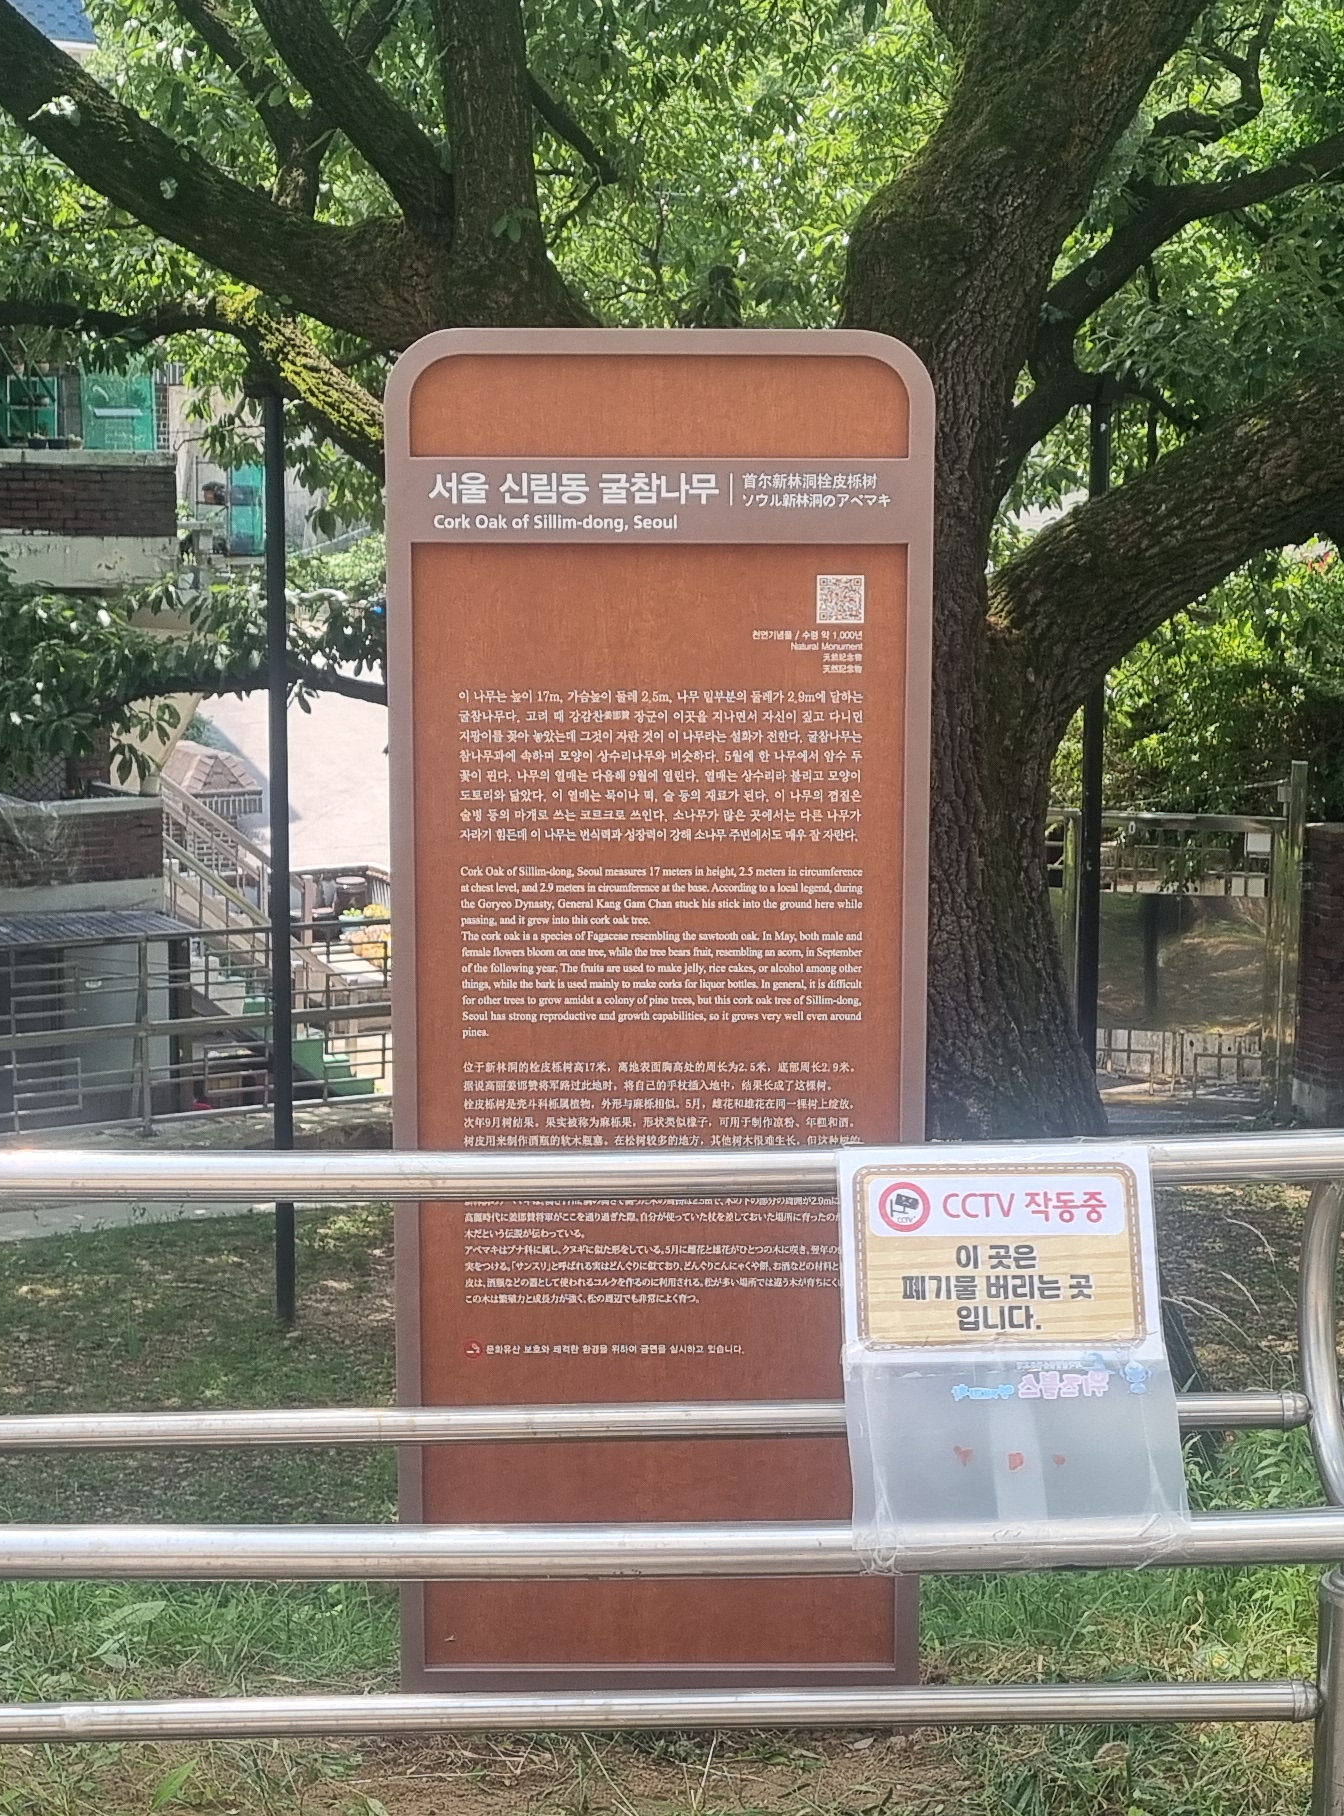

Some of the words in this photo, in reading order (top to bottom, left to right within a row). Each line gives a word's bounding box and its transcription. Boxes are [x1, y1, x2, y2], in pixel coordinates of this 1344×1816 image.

[742, 473, 877, 489] 首尔新林洞栓皮栎树
[429, 473, 489, 504] 서울
[499, 473, 589, 504] 신림동
[599, 473, 719, 504] 굴참나무
[743, 493, 890, 508] ソウル新林洞のアベマキ
[434, 514, 470, 529] Cork
[475, 514, 506, 529] Oak
[512, 513, 529, 529] of
[533, 514, 628, 532] Sillim-dong,
[634, 514, 677, 529] Seoul
[753, 630, 792, 640] 천연기념물
[791, 642, 819, 651] Natural
[822, 642, 862, 651] Monument
[459, 690, 469, 703] 이
[474, 690, 507, 703] 나무는
[511, 690, 532, 703] 높이
[568, 690, 611, 703] 가슴높이
[616, 690, 637, 703] 둘레
[677, 690, 699, 703] 나무
[704, 690, 746, 703] 밑부분의
[751, 690, 784, 703] 둘레가
[830, 690, 863, 703] 달하는
[460, 730, 503, 743] 지팡이를
[507, 730, 529, 743] 꽂아
[533, 730, 576, 743] 놓았는데
[580, 730, 612, 743] 그것이
[617, 730, 639, 743] 자란
[643, 730, 663, 743] 것이
[668, 730, 678, 743] 이
[683, 730, 726, 743] 나무라는
[731, 730, 763, 743] 설화가
[808, 730, 862, 743] 굴참나무는
[460, 749, 515, 762] 참나무과에
[521, 749, 553, 763] 속하며
[559, 749, 592, 763] 모양이
[598, 750, 666, 763] 상수리나무와
[725, 750, 753, 762] 5월에
[759, 750, 770, 762] 한
[775, 750, 818, 763] 나무에서
[824, 750, 846, 763] 암수
[851, 751, 862, 763] 두
[460, 769, 481, 782] 꽃이
[487, 769, 511, 782] 핀다.
[517, 769, 549, 782] 나무의
[555, 769, 588, 782] 열매는
[592, 769, 625, 782] 다음해
[630, 769, 657, 783] 9월에
[663, 769, 699, 783] 열린다.
[705, 769, 737, 782] 열매는
[742, 769, 786, 782] 상수리라
[791, 769, 823, 783] 불리고
[828, 770, 860, 782] 모양이
[461, 866, 483, 876] Cork
[486, 866, 504, 876] Oak
[507, 866, 517, 876] of
[519, 866, 574, 878] Sillim-dong,
[577, 867, 602, 876] Seoul
[650, 867, 660, 876] 17
[663, 868, 692, 876] meters
[695, 866, 703, 876] in
[706, 866, 736, 878] height,
[739, 867, 753, 876] 2.5
[756, 868, 785, 876] meters
[788, 867, 797, 876] in
[800, 867, 863, 876] circumference
[461, 899, 475, 908] the
[478, 899, 512, 911] Goryeo
[515, 899, 554, 910] Dynasty,
[558, 899, 593, 908] General
[597, 899, 621, 910] Kang
[624, 899, 645, 908] Gam
[648, 899, 672, 908] Chan
[675, 899, 699, 908] stuck
[702, 899, 715, 908] his
[718, 899, 740, 908] stick
[743, 899, 760, 908] into
[763, 899, 777, 908] the
[780, 899, 812, 910] ground
[815, 899, 834, 908] here
[837, 899, 862, 908] while
[461, 915, 497, 927] passing,
[500, 915, 516, 924] and
[519, 915, 525, 924] it
[528, 917, 549, 926] grew
[552, 915, 569, 924] into
[572, 915, 588, 924] this
[590, 915, 610, 924] cork
[613, 915, 629, 924] oak
[631, 916, 650, 924] tree.
[462, 1011, 488, 1021] Seoul
[491, 1011, 506, 1020] has
[509, 1012, 537, 1022] strong
[540, 1011, 596, 1023] reproductive
[599, 1011, 615, 1020] and
[618, 1011, 650, 1022] growth
[653, 1011, 706, 1023] capabilities,
[722, 1011, 729, 1020] it
[732, 1014, 759, 1022] grows
[762, 1014, 781, 1023] very
[784, 1011, 803, 1020] well
[830, 1011, 861, 1020] around
[943, 1192, 1015, 1219] CCTV
[1024, 1191, 1107, 1223] 작동중
[956, 1245, 979, 1269] 이
[988, 1244, 1037, 1269] 곳은
[902, 1275, 978, 1300] 폐기물
[985, 1275, 1062, 1300] 버리는
[1069, 1274, 1093, 1300] 곳
[956, 1306, 1042, 1331] 입니다.
